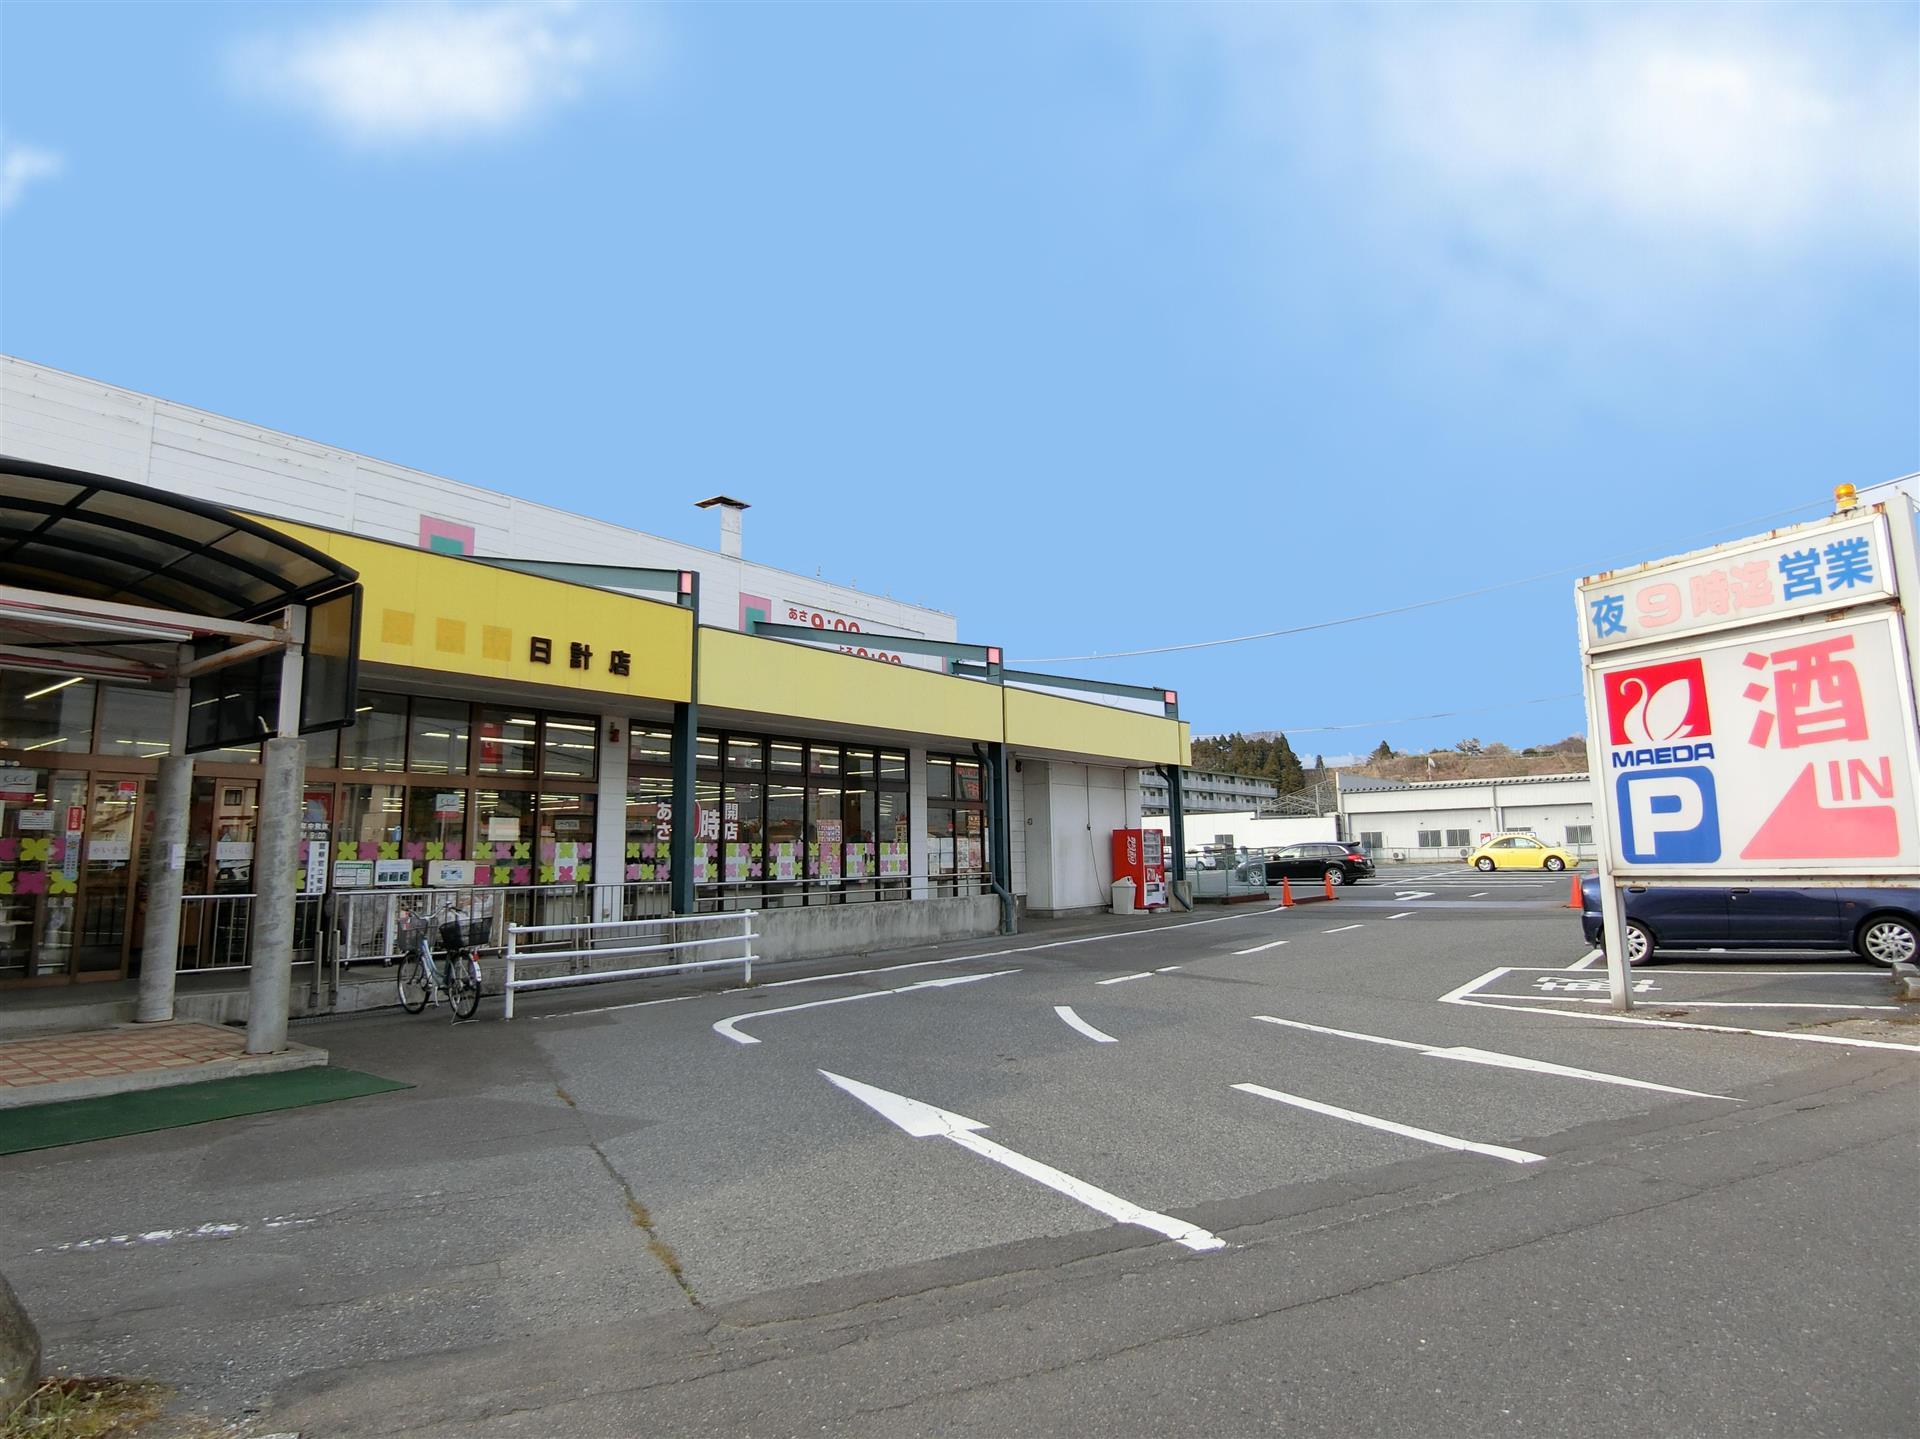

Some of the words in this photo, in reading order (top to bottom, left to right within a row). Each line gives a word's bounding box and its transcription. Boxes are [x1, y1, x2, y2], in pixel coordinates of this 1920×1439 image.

[1590, 536, 1874, 639] 夜9時迄営業
[529, 636, 632, 677] 日計店
[1741, 634, 1870, 750] 酒
[1611, 742, 1715, 768] MAEDA
[1828, 756, 1895, 801] IN
[656, 802, 672, 840] あさ
[700, 809, 720, 840] 時
[724, 803, 738, 840] 開店
[1627, 775, 1704, 856] P
